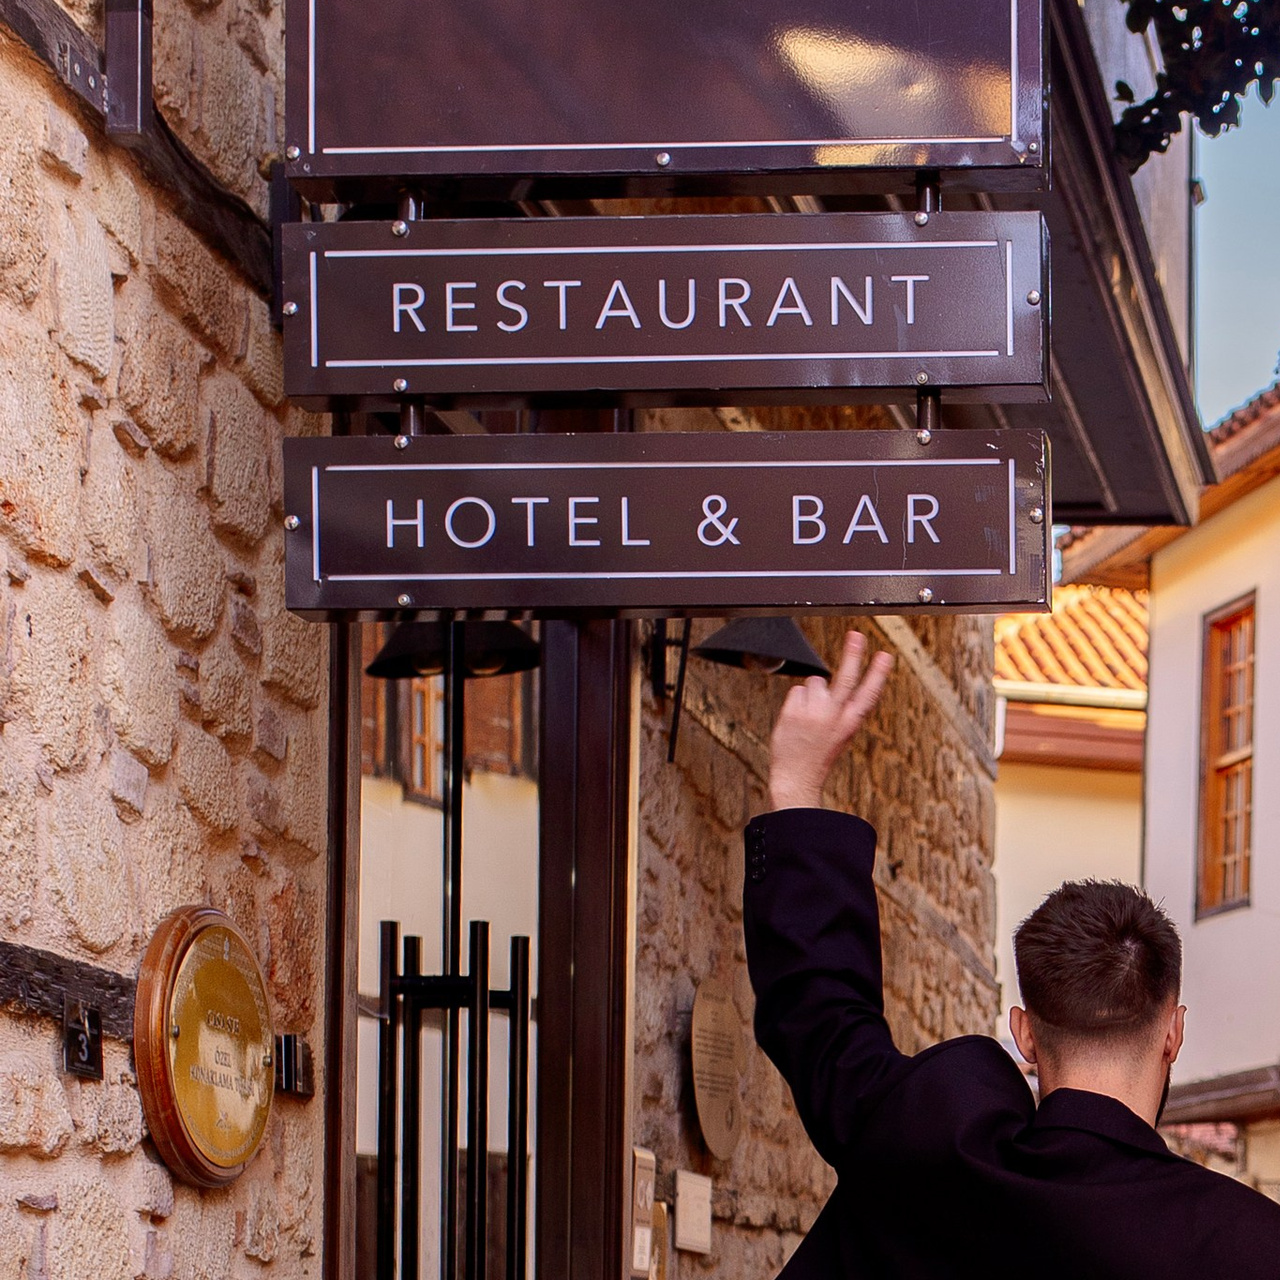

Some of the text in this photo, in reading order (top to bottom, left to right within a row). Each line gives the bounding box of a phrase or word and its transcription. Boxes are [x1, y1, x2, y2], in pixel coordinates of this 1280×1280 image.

[391, 274, 931, 334] RESTAURANT
[385, 493, 941, 549] HOTEL & BAR
